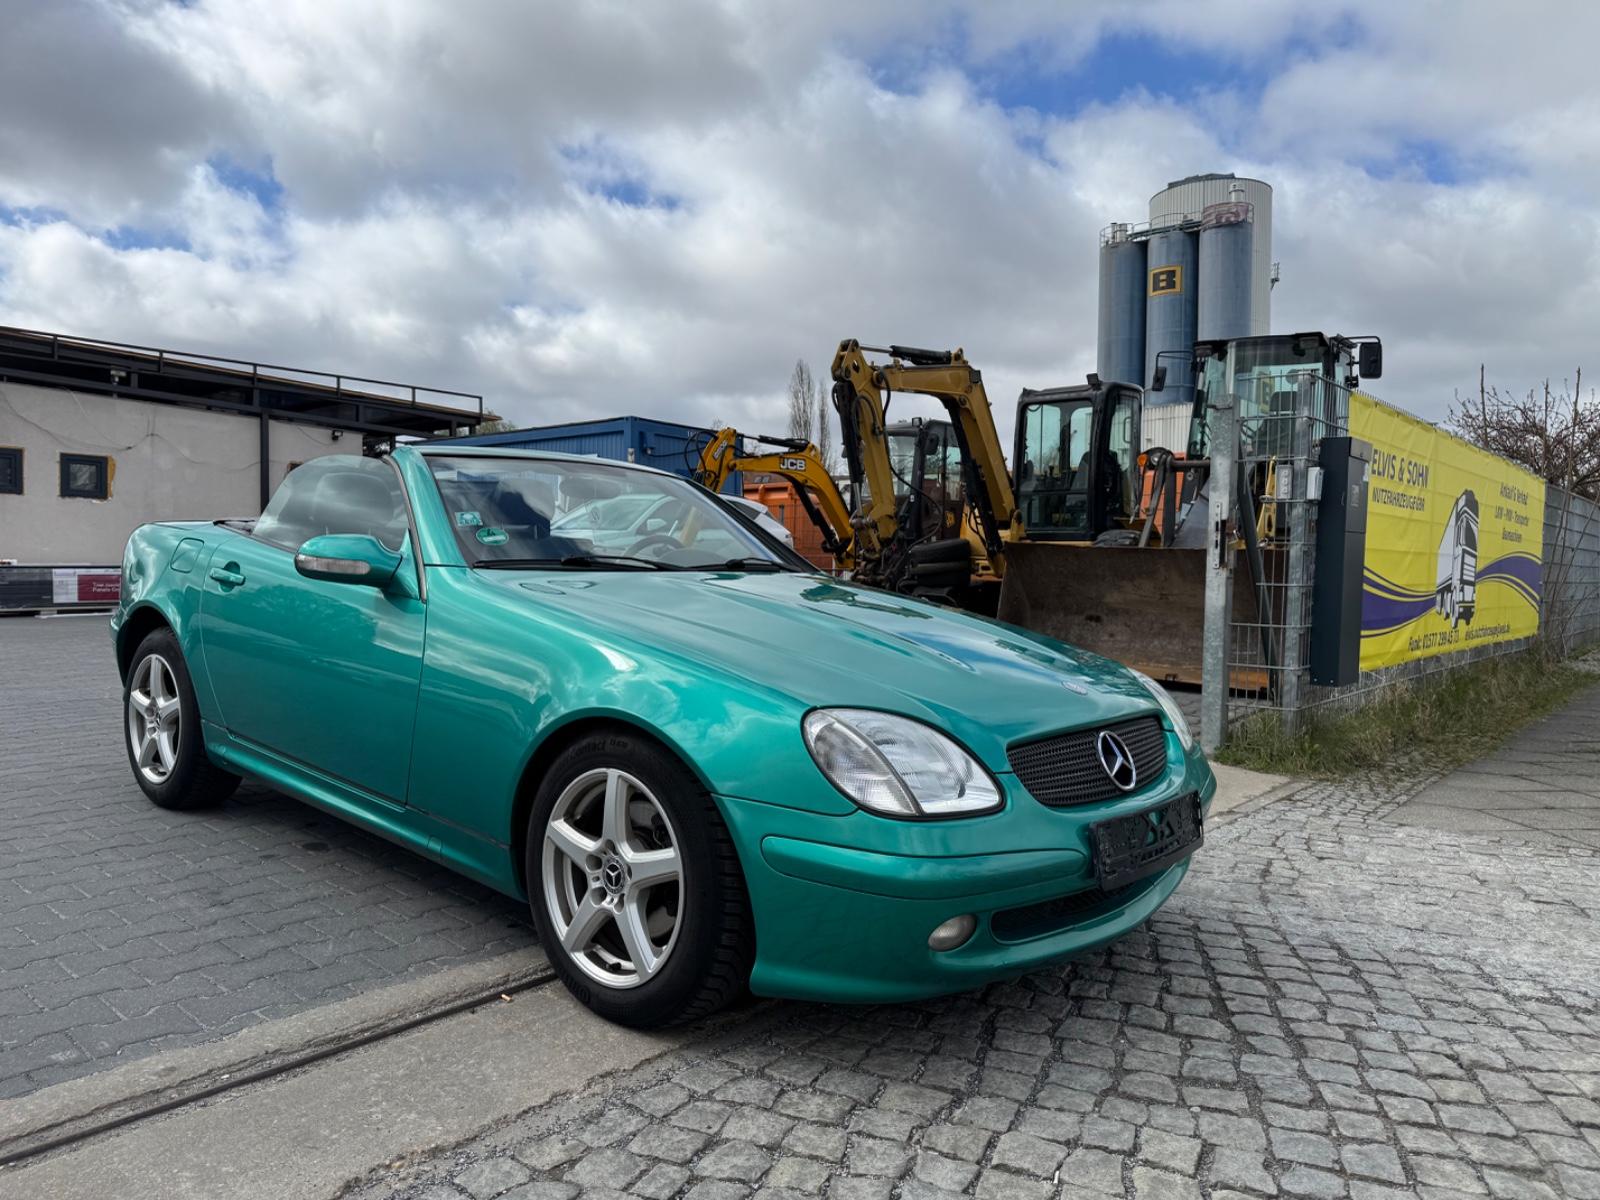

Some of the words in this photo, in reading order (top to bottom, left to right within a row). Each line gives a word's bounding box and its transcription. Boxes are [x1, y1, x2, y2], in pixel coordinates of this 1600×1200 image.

[1152, 270, 1176, 293] B
[780, 458, 806, 470] JCB
[1371, 448, 1397, 480] ELVIS
[1398, 457, 1405, 483] &
[1406, 460, 1430, 489] SOHN
